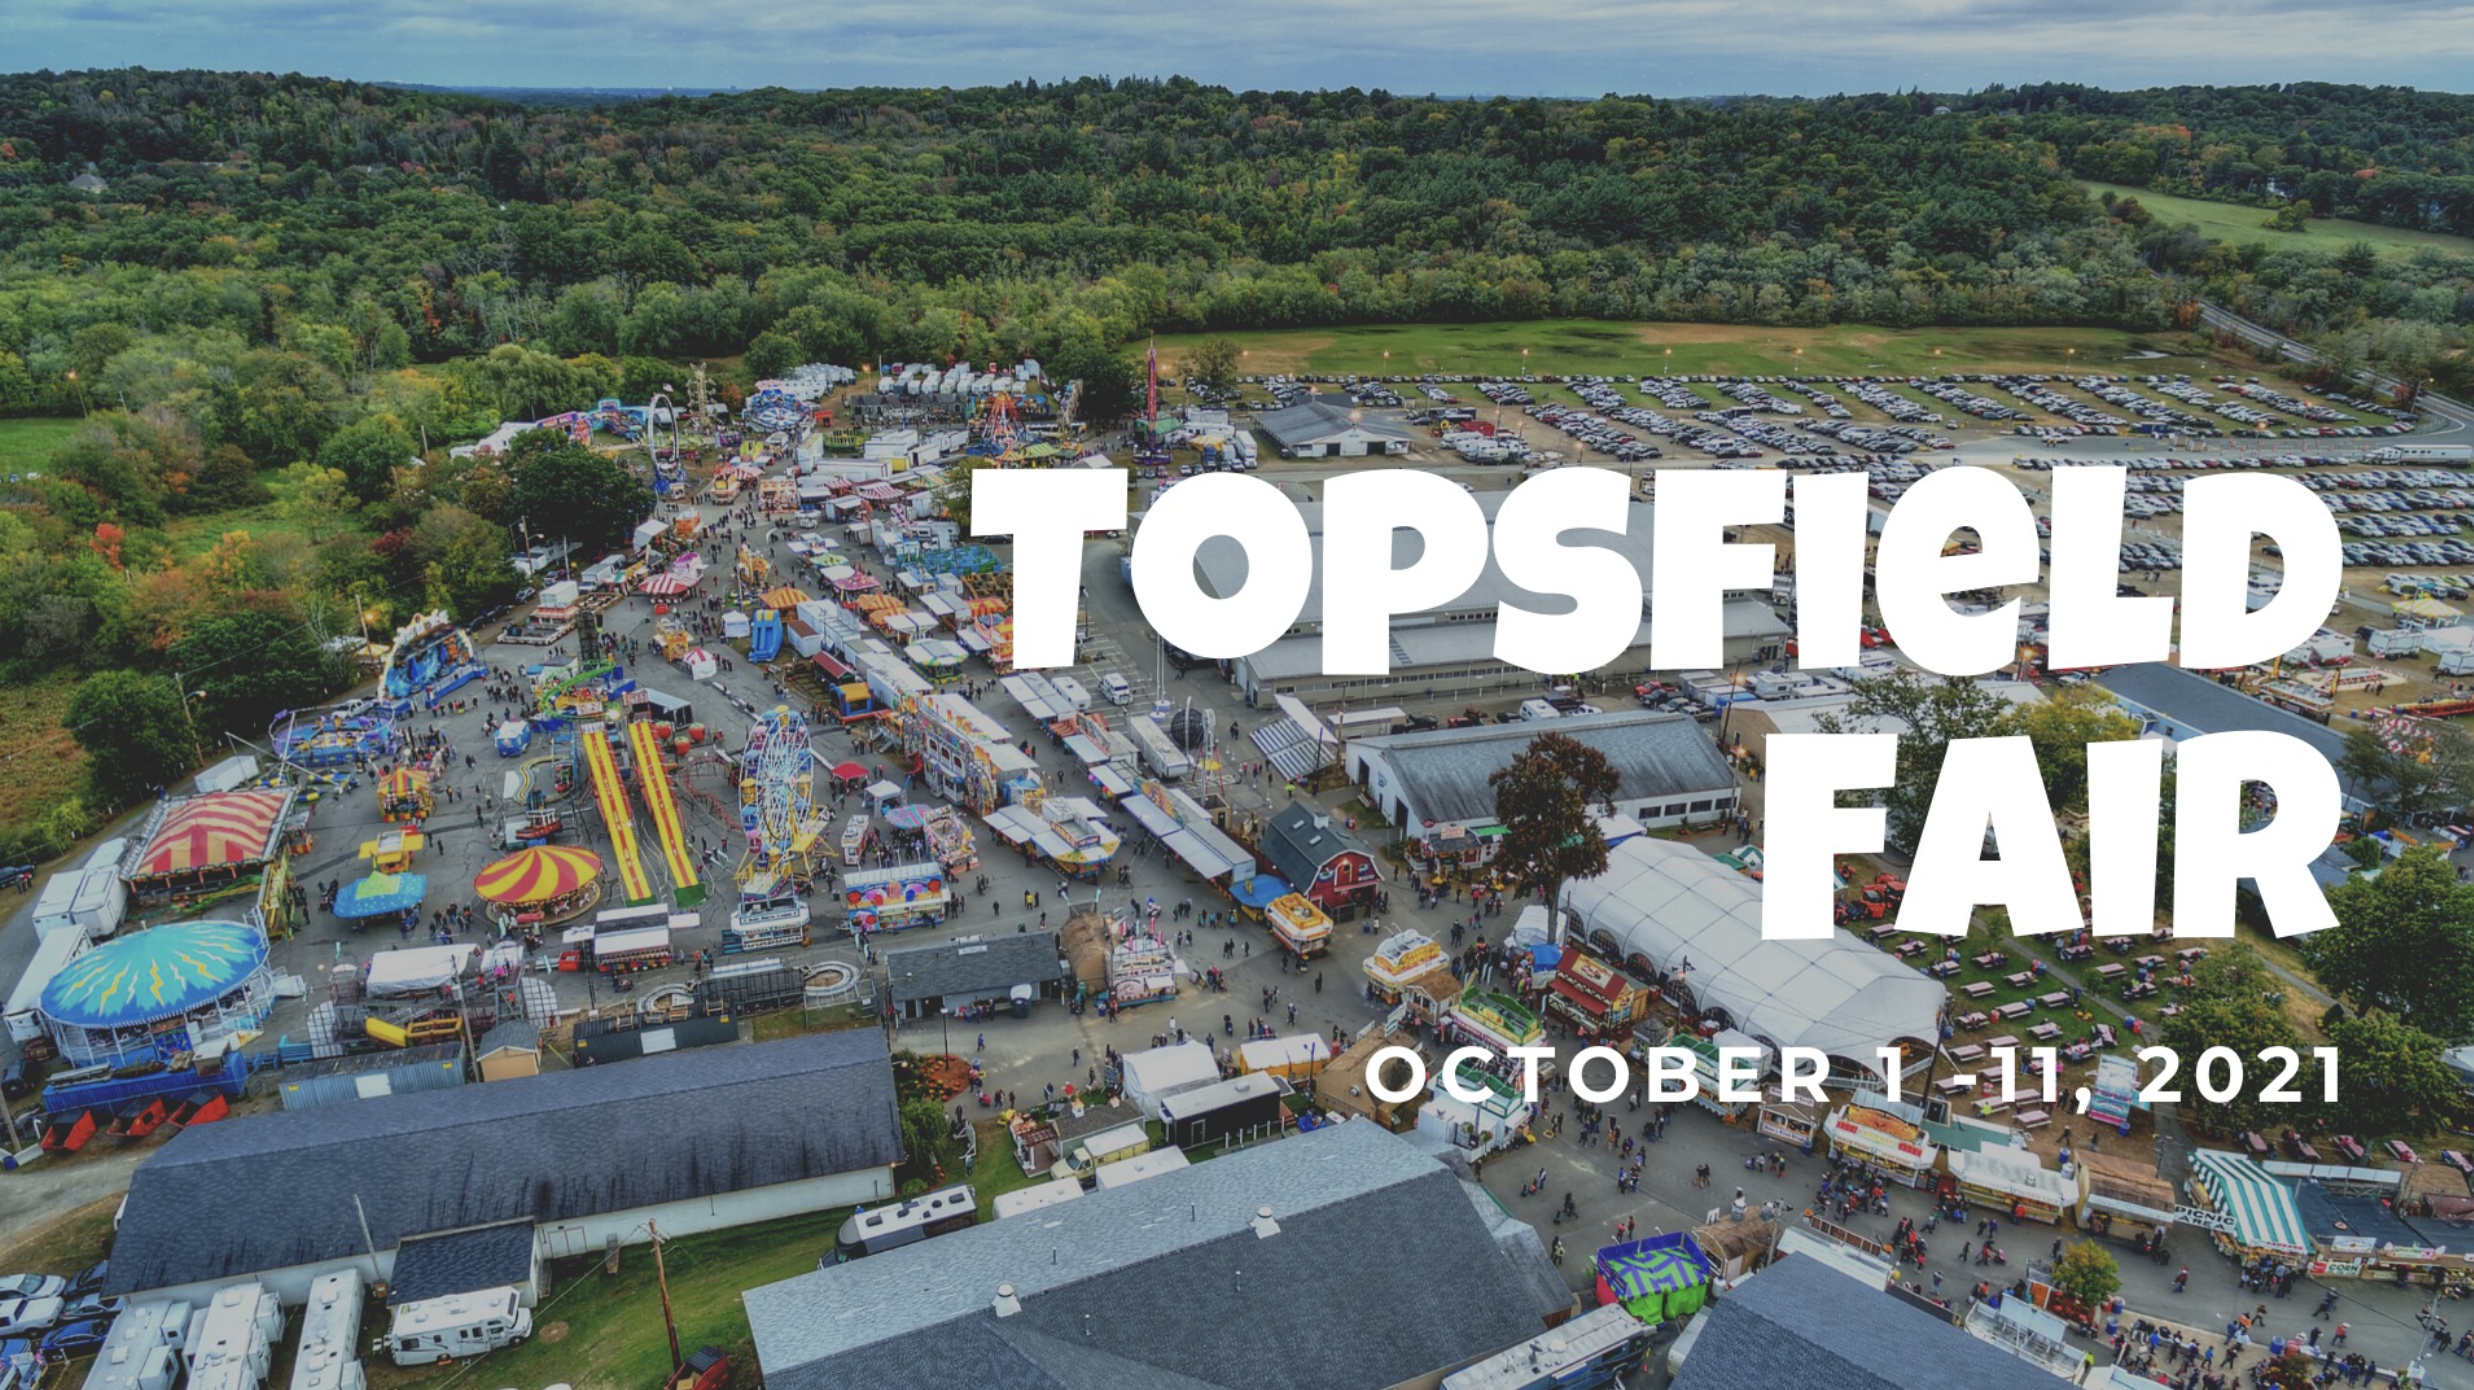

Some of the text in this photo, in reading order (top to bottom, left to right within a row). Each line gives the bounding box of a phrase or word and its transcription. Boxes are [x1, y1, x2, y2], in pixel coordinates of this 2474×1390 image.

[2175, 1206, 2235, 1226] PICNIC
[2178, 1215, 2226, 1230] AREA
[2328, 1263, 2359, 1272] CORN
